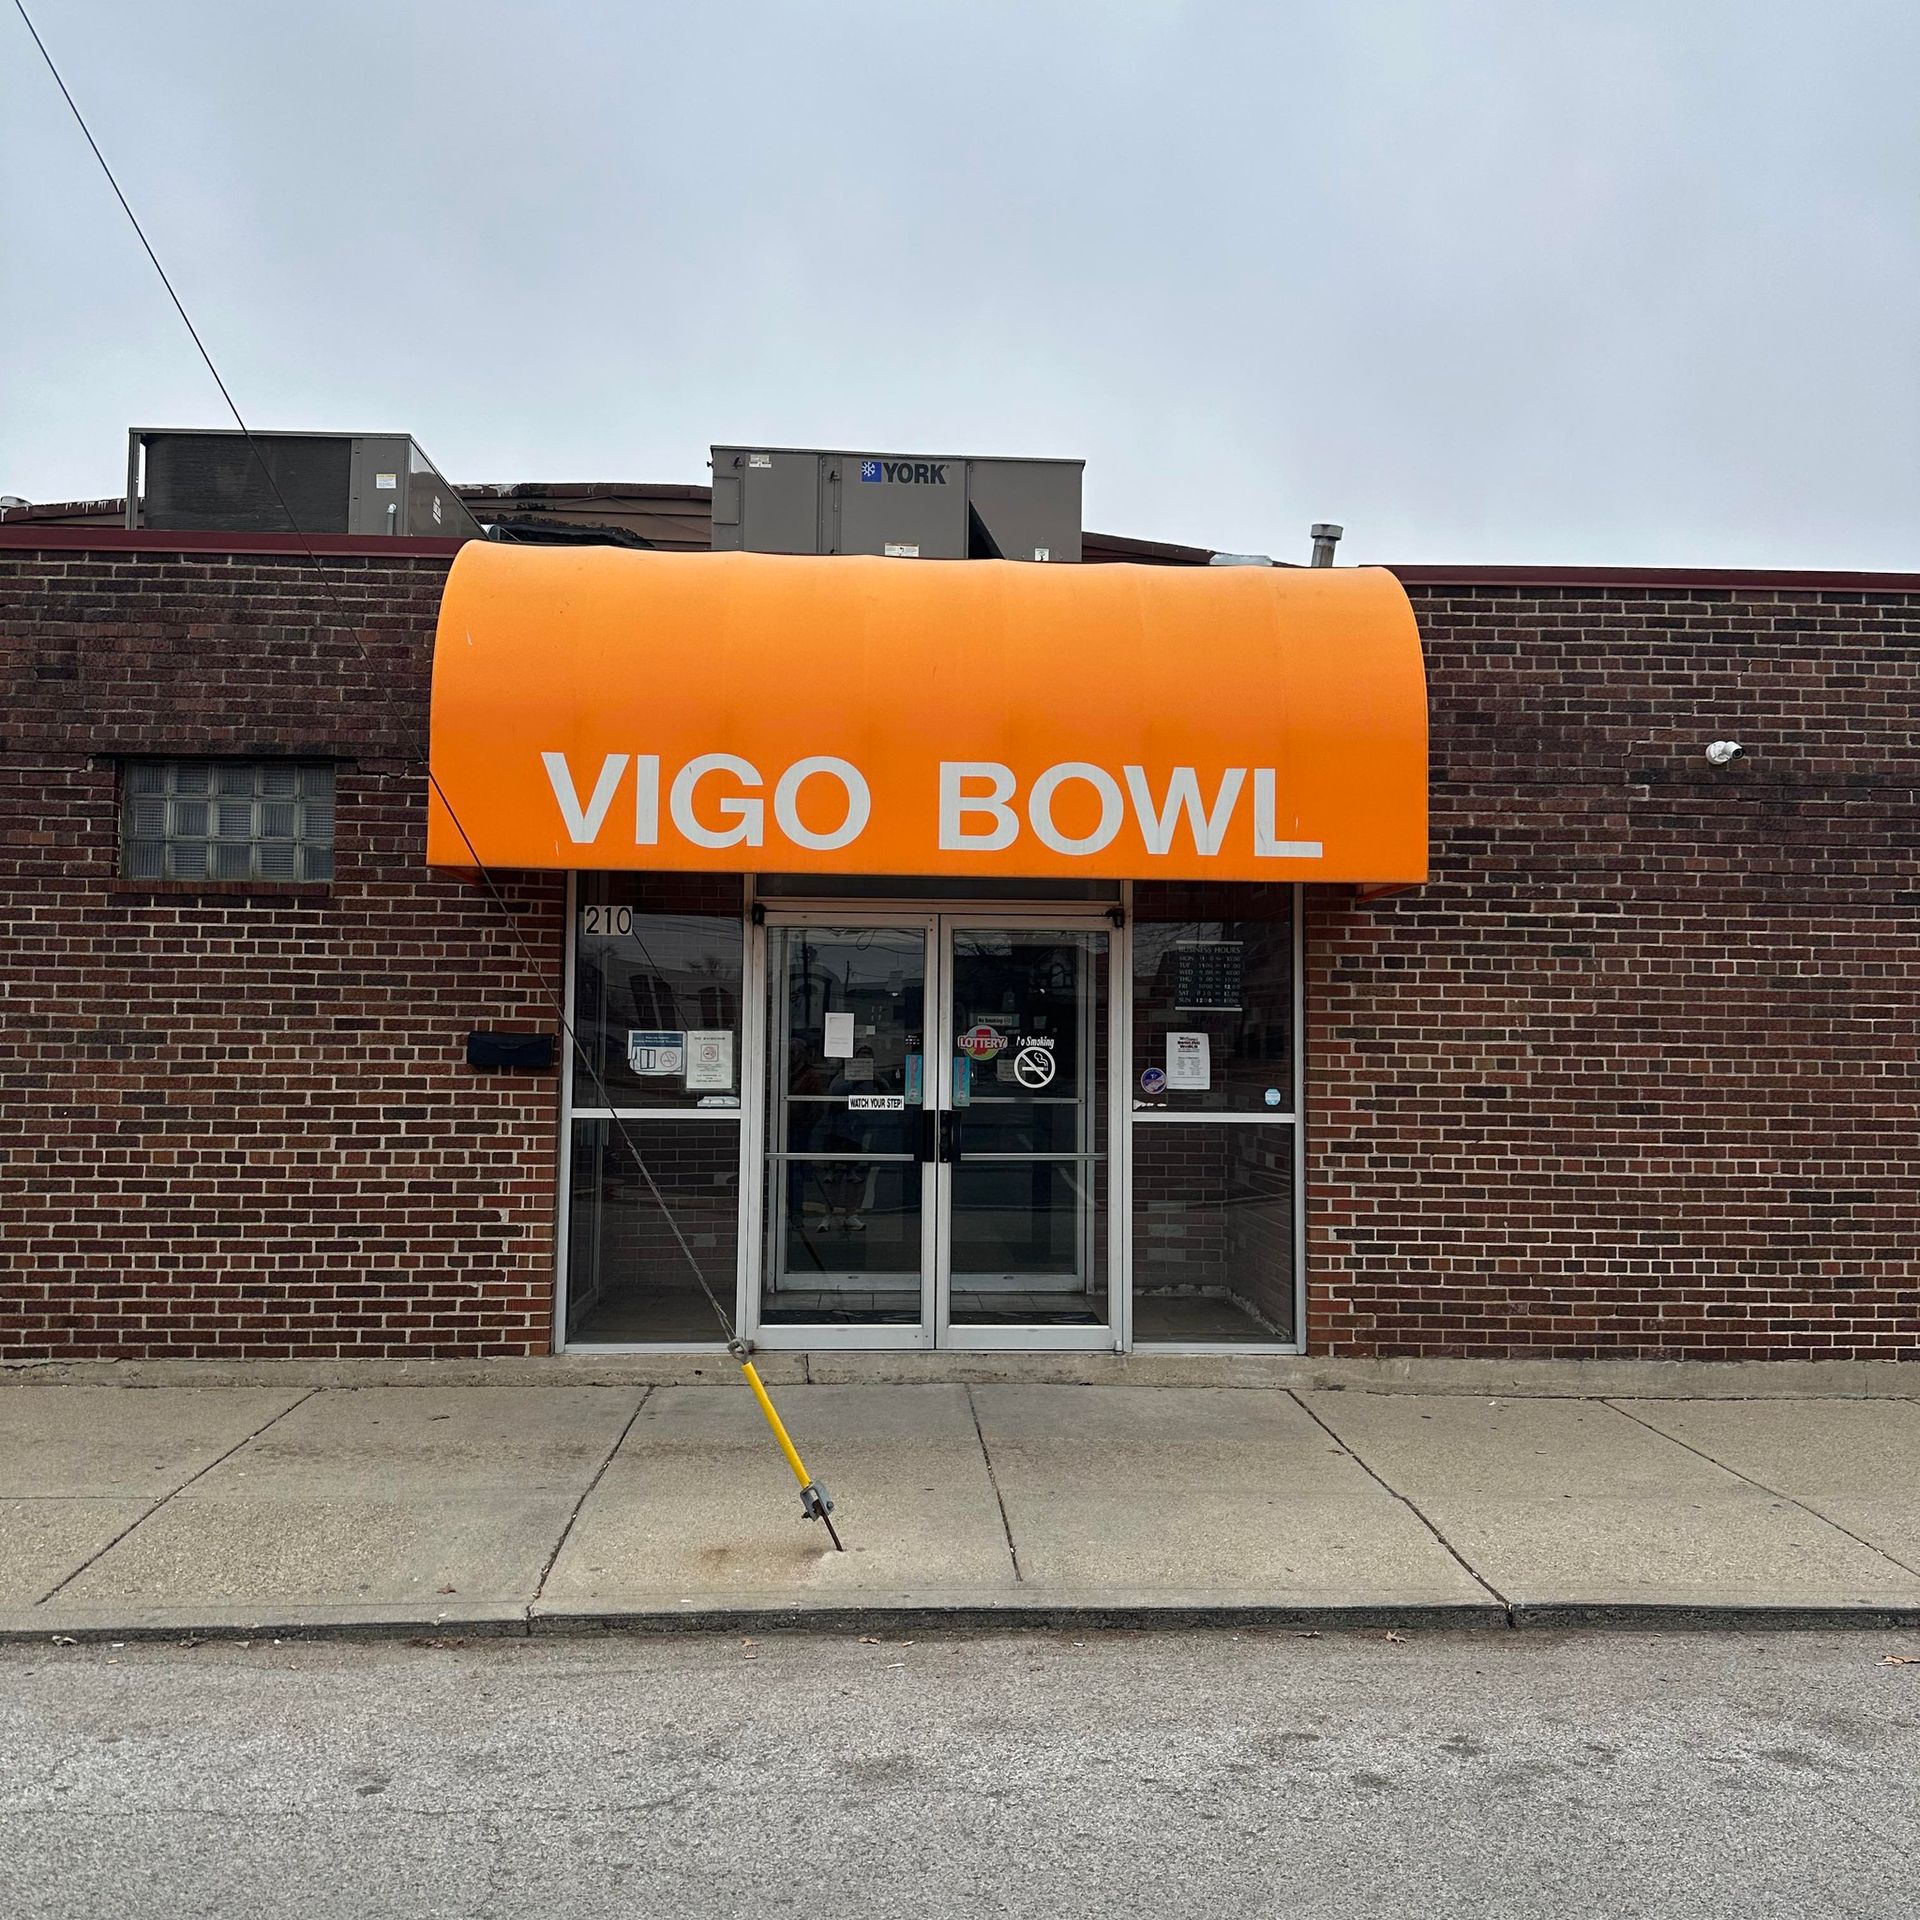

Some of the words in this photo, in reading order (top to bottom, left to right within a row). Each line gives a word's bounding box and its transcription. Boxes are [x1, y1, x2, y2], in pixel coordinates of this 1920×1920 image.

[883, 463, 946, 484] YORK
[540, 751, 871, 850] VIGO
[938, 761, 1323, 858] BOWL
[586, 906, 632, 935] 210
[960, 1037, 1005, 1048] LOTTERY
[1026, 1035, 1055, 1049] Smoking
[850, 1098, 869, 1108] WATCH
[870, 1098, 885, 1108] YOUR
[887, 1099, 903, 1108] STEP!
